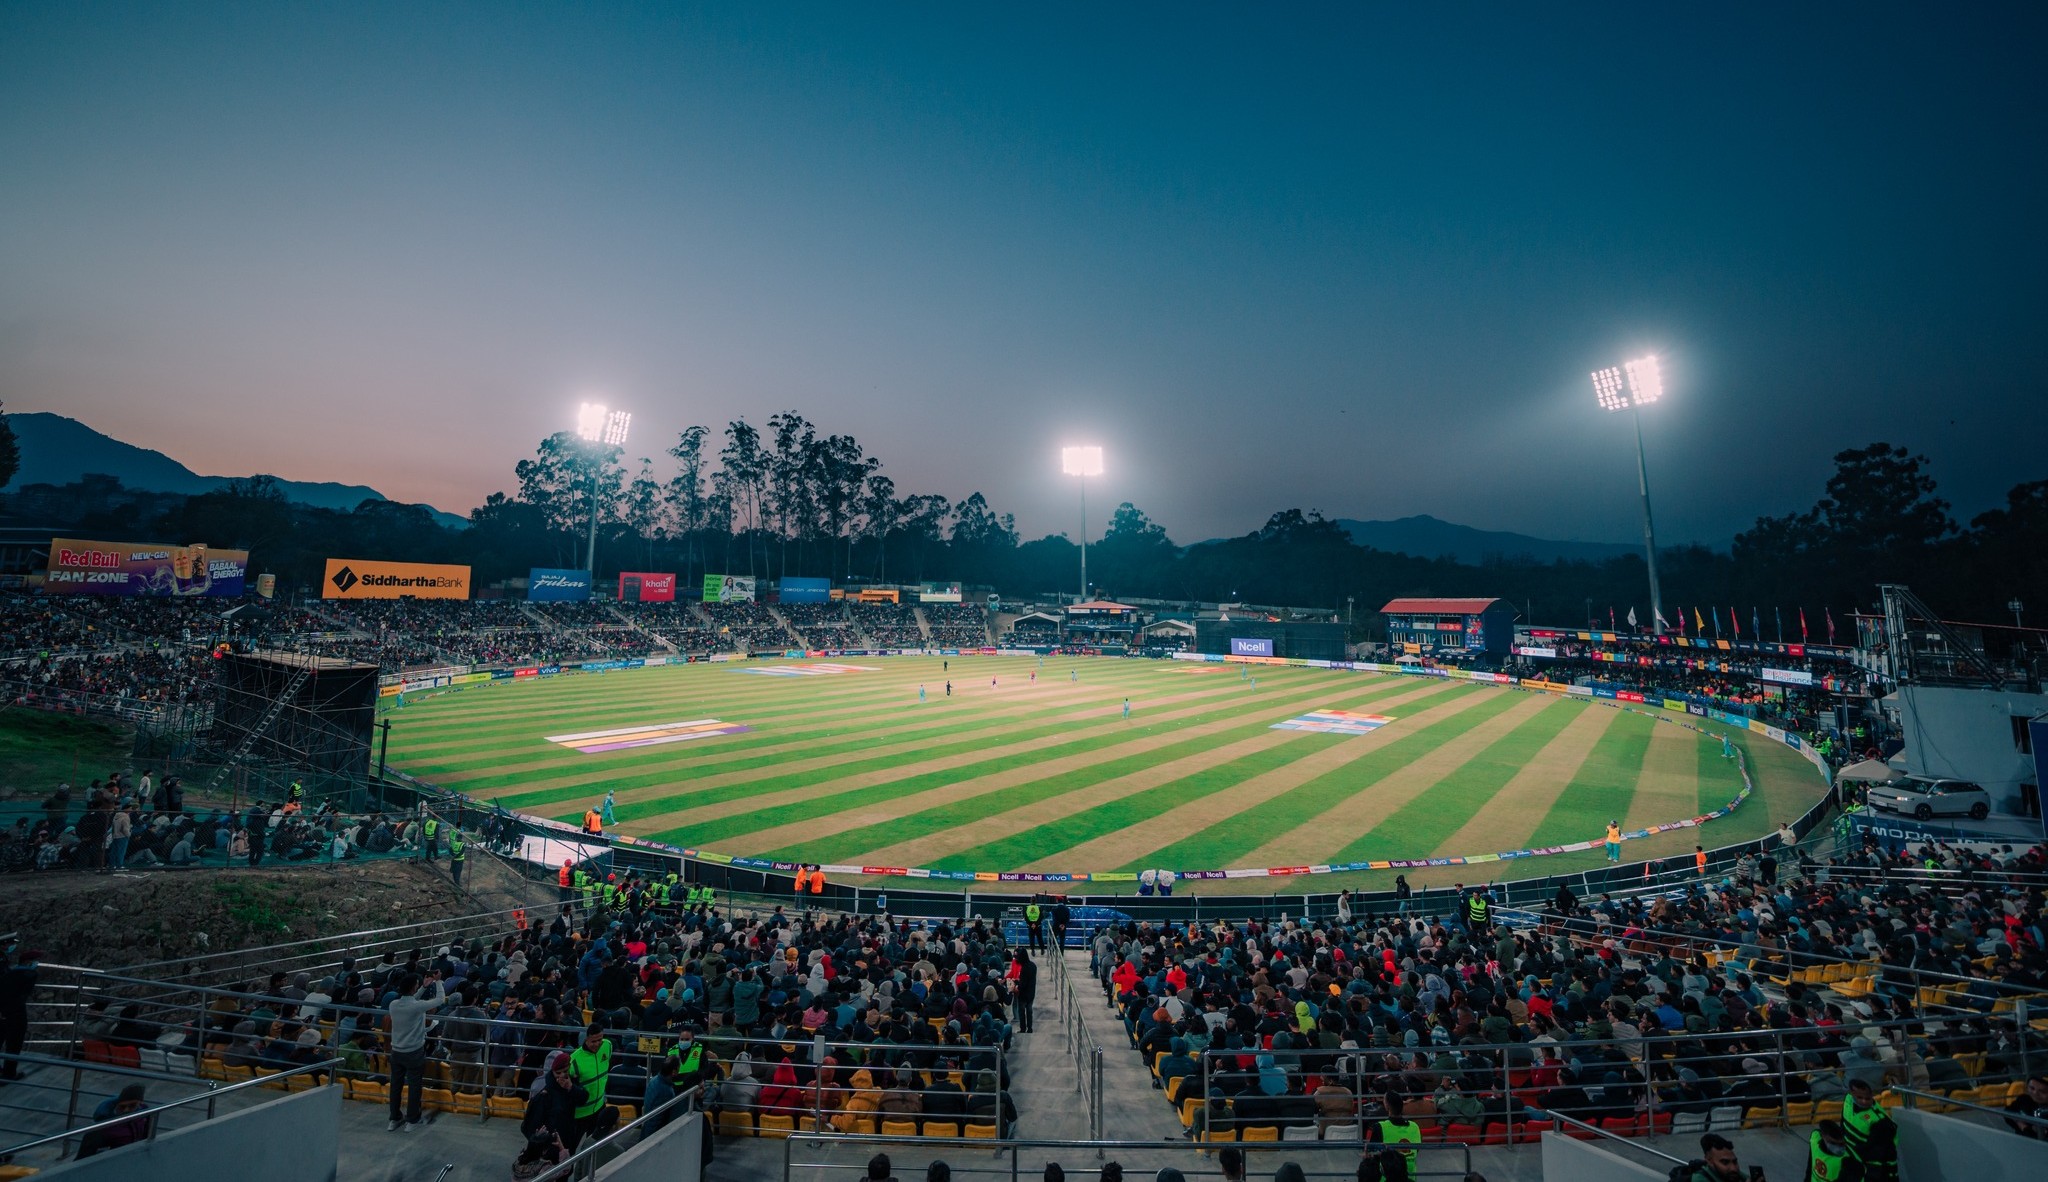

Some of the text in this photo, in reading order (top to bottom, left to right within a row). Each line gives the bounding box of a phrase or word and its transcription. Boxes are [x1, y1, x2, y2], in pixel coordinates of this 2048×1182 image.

[59, 549, 121, 568] Red Bull
[131, 551, 169, 561] NEW-GEN
[209, 561, 238, 571] BABAAL
[49, 570, 129, 583] FAN ZONE
[1238, 641, 1265, 652] Ncell
[1689, 705, 1704, 716] Ncell
